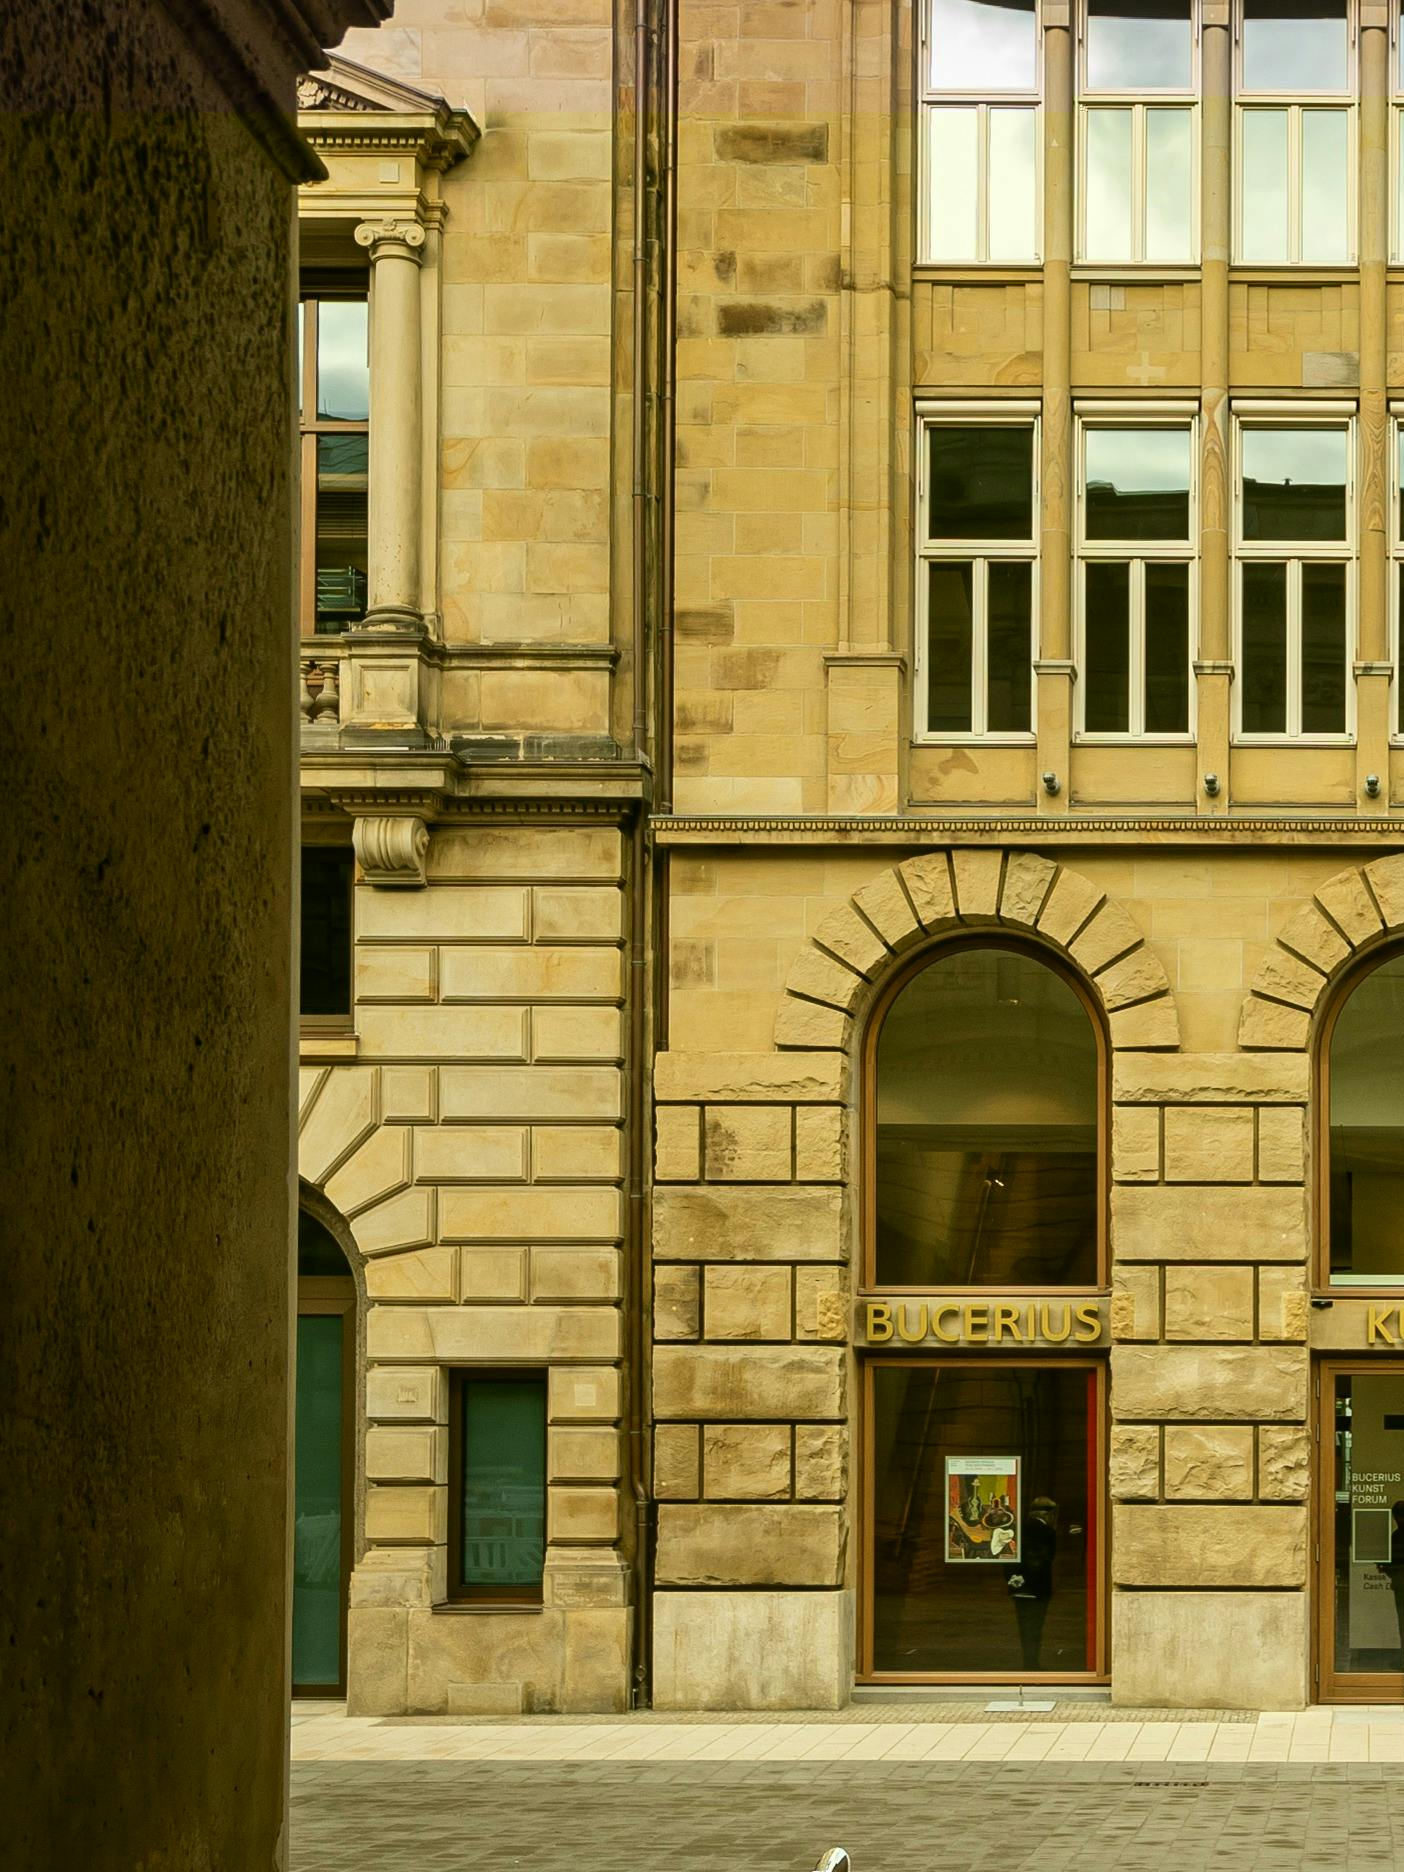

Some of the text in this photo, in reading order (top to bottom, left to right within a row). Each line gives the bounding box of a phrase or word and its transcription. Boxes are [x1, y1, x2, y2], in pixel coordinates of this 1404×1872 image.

[866, 1302, 1102, 1344] BUCERIUS
[1352, 1472, 1401, 1482] BUCERIUS
[1352, 1484, 1385, 1493] KUNST
[1352, 1495, 1388, 1504] FORUM
[1363, 1582, 1384, 1590] Cash
